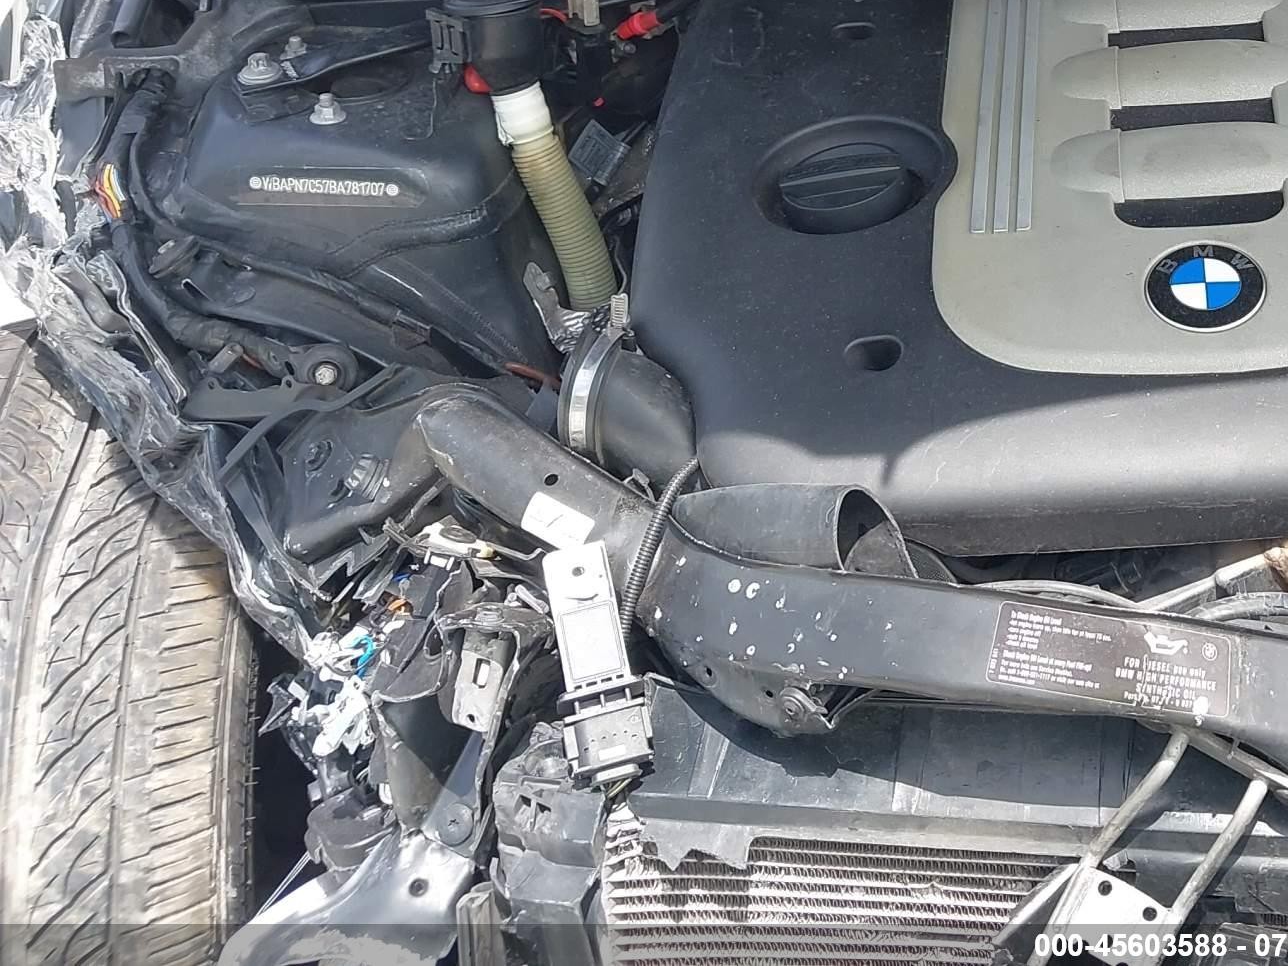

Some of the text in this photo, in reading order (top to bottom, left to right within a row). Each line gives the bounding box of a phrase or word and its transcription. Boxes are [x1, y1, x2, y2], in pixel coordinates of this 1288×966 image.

[1156, 245, 1256, 275] BMW
[1124, 656, 1141, 669] FOR
[1115, 666, 1135, 680] BMW
[1159, 674, 1217, 691] PERFORMANCE
